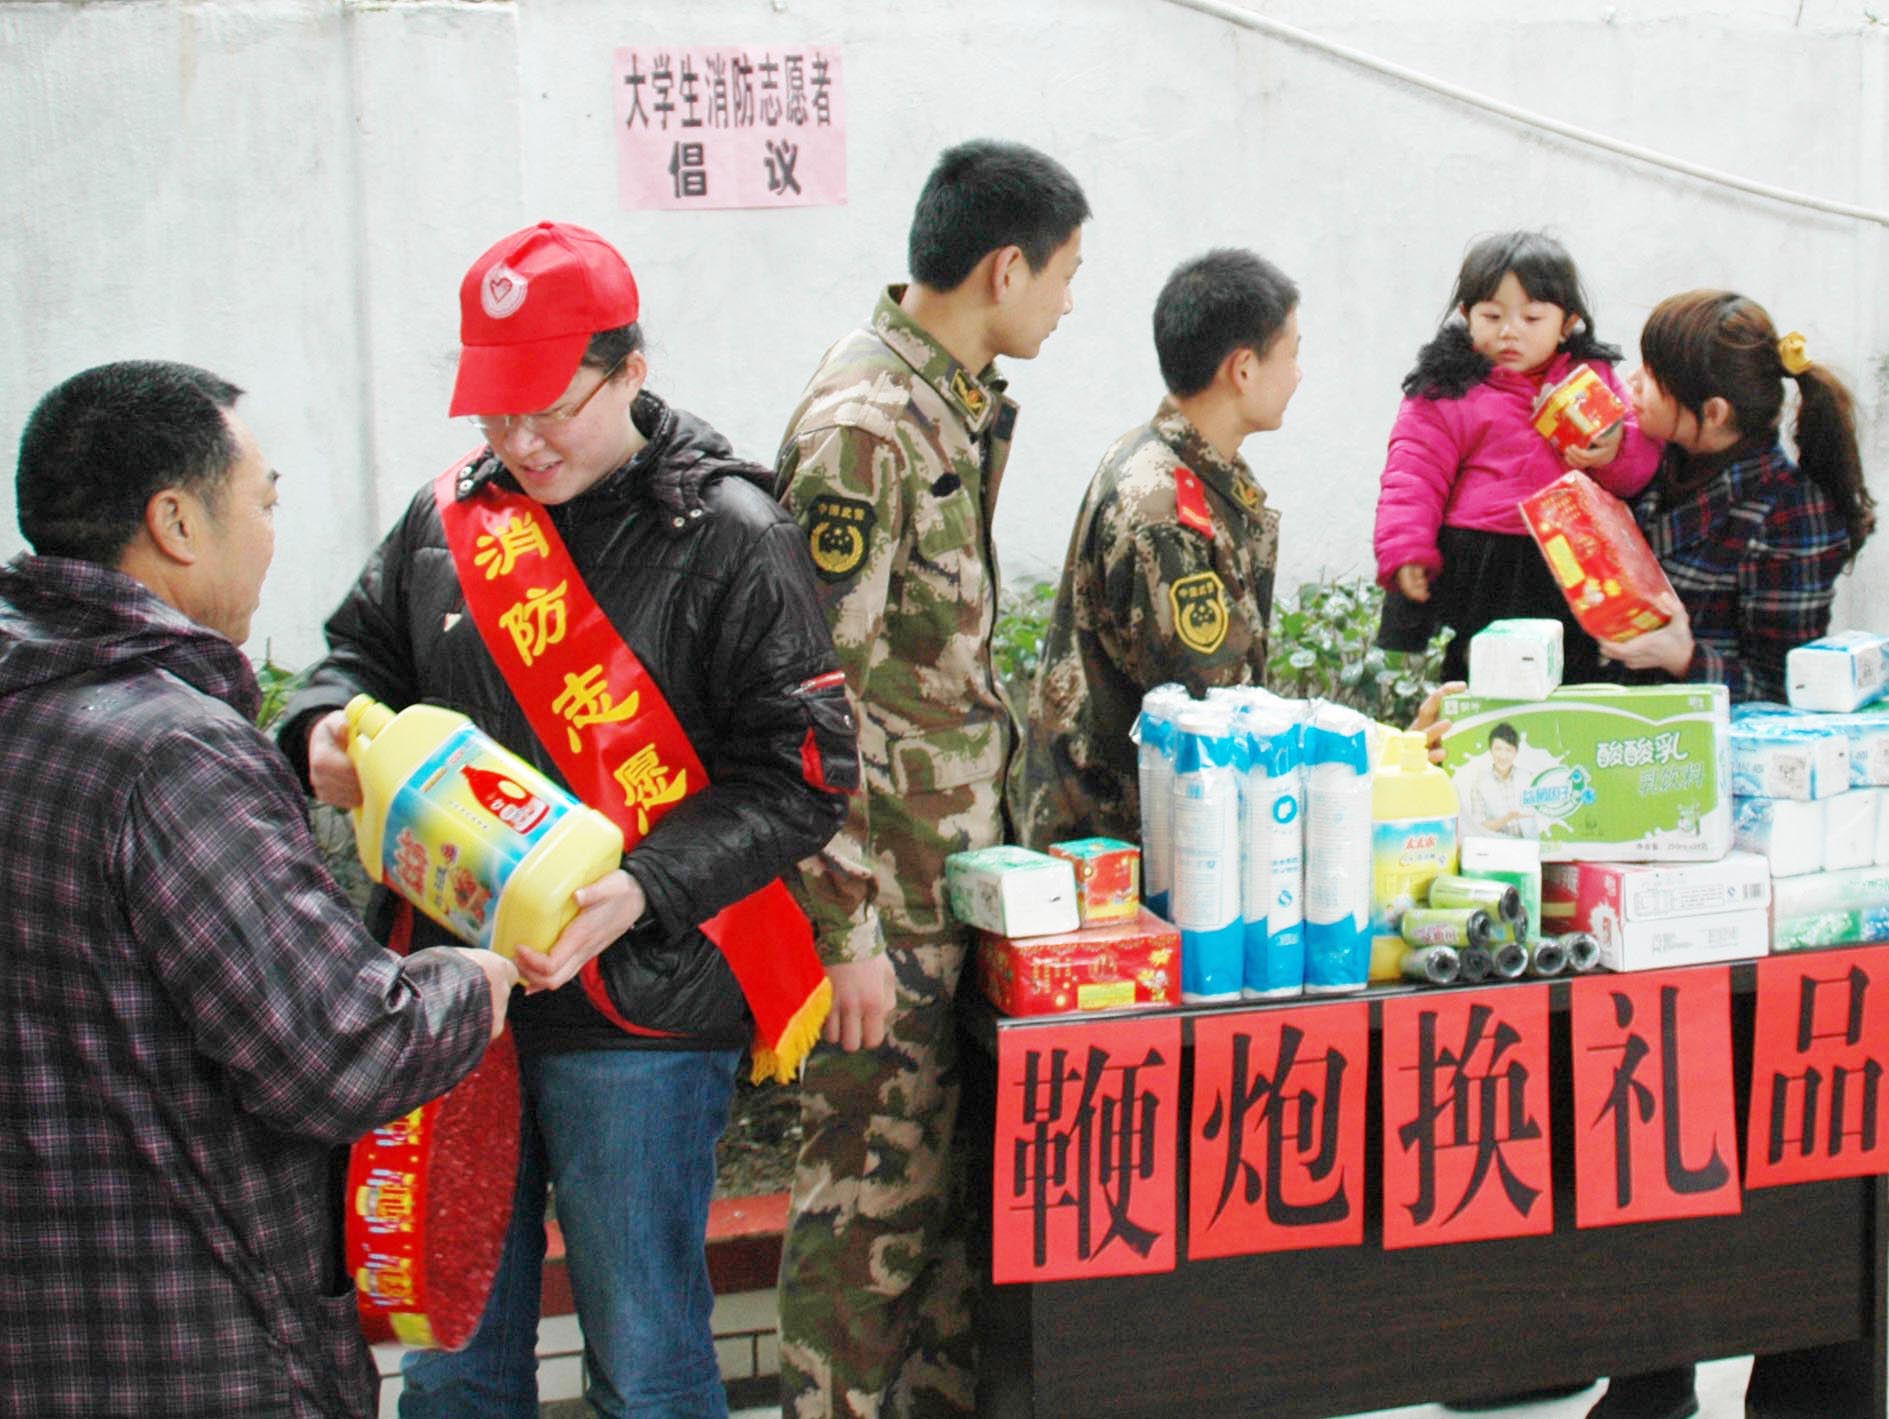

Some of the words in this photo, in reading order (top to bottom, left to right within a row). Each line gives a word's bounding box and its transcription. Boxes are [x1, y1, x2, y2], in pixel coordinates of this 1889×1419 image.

[624, 53, 832, 130] 大学生消防志愿者
[668, 140, 801, 198] 倡议
[1596, 731, 1690, 769] 酸酸乳
[1009, 964, 1884, 1268] 鞭炮换礼品
